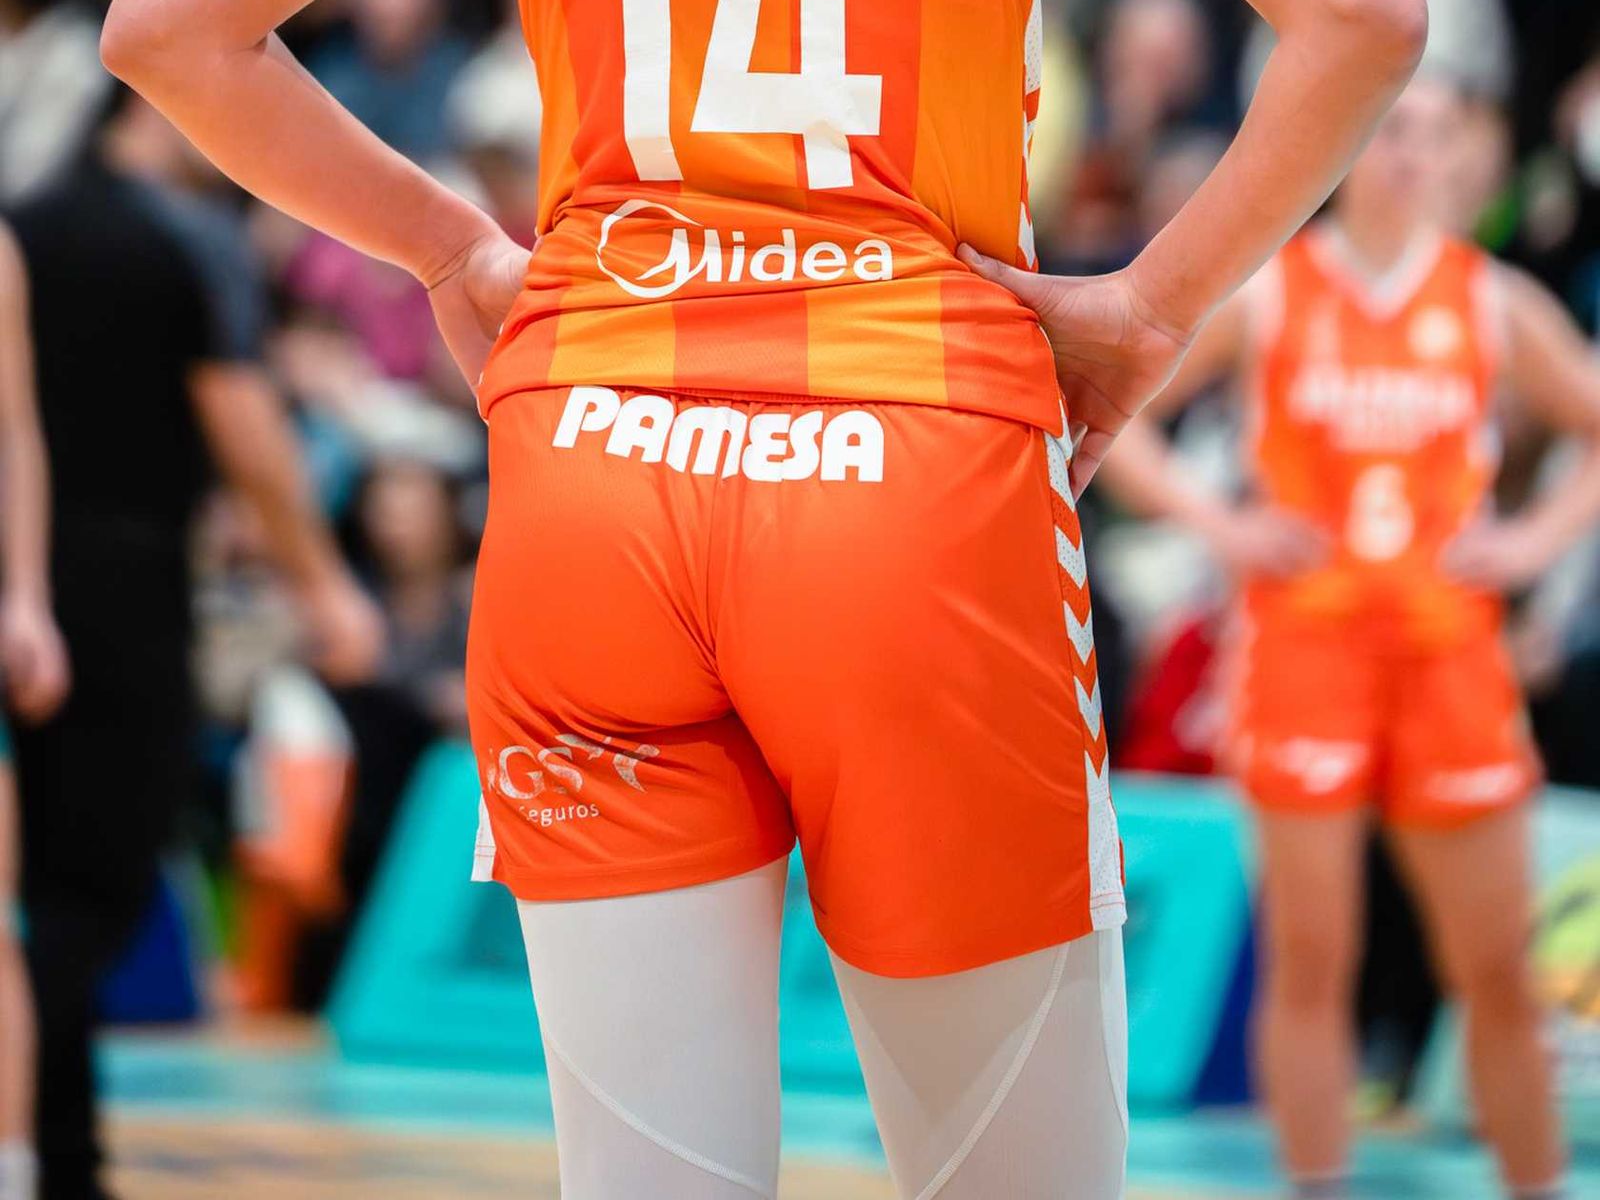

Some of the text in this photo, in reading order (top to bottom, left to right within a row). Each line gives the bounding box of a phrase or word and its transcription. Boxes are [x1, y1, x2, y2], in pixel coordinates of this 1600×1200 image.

[636, 227, 894, 283] Midea
[552, 386, 884, 483] PAMESA
[518, 803, 600, 827] eguros
